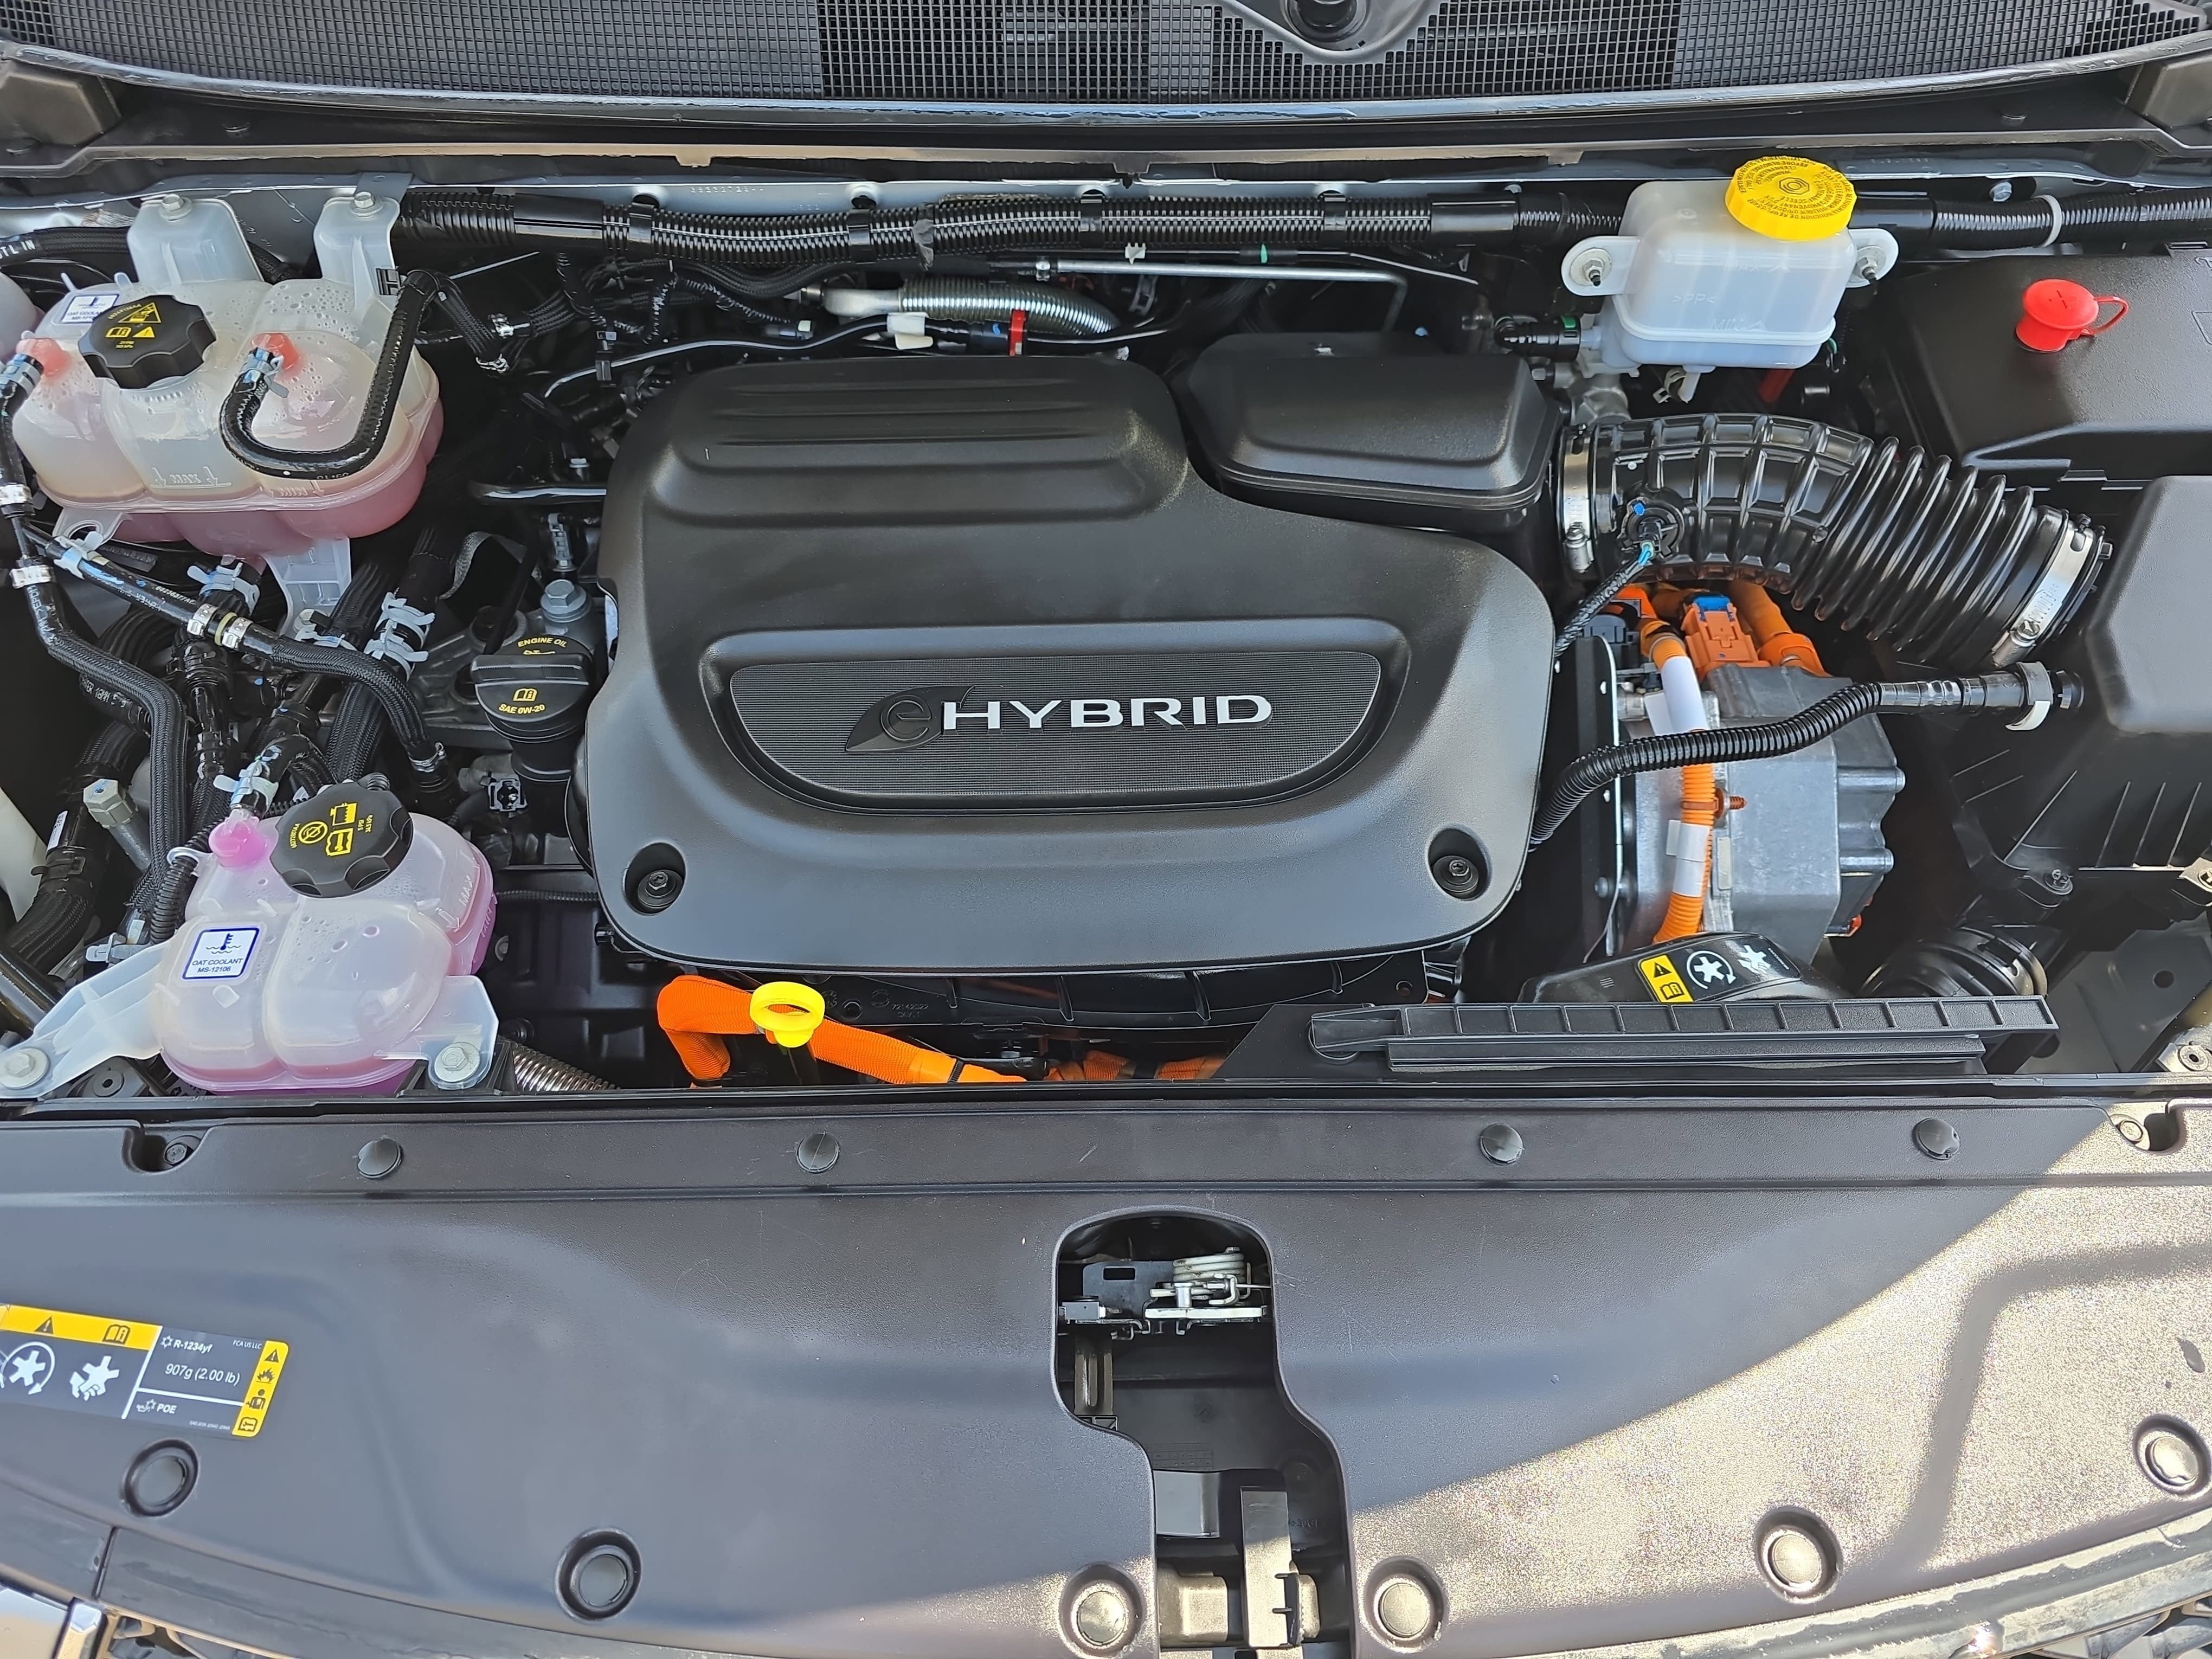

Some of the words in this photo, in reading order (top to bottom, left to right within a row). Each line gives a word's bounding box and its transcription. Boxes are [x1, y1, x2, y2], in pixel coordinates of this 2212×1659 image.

[0, 245, 20, 259] TL
[20, 239, 36, 251] IN
[517, 636, 554, 648] ENGINE
[554, 639, 568, 648] OIL
[498, 703, 518, 715] SAE
[517, 704, 545, 715] 0W-20
[943, 695, 1273, 732] HYBRID
[173, 1339, 214, 1354] R-1234yf
[165, 1362, 194, 1380] 907g
[194, 1367, 224, 1381] (2.00
[224, 1371, 240, 1386] lb)
[157, 1403, 177, 1414] POE
